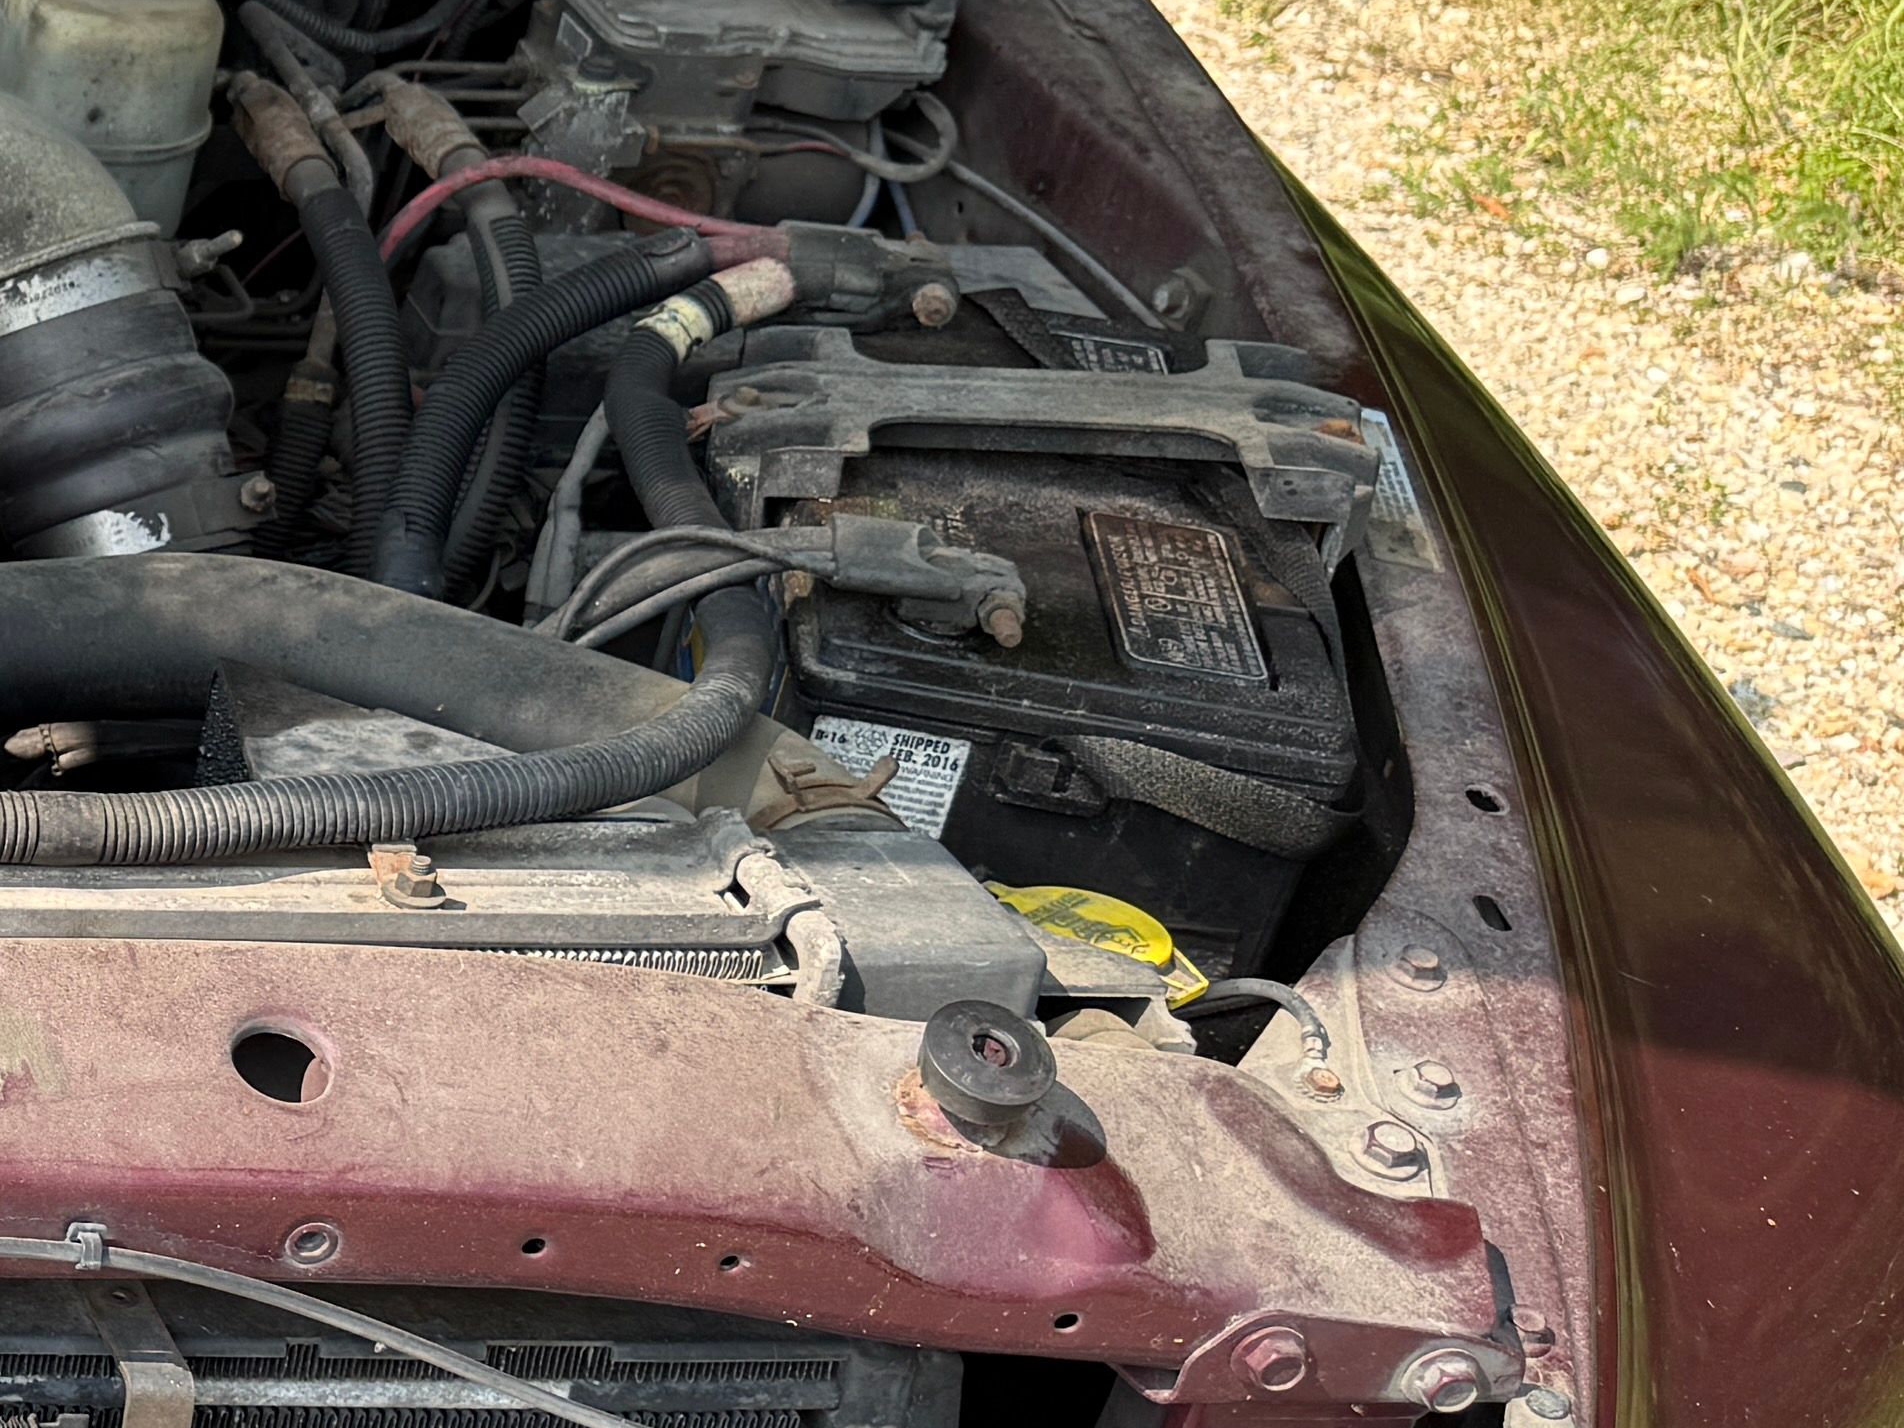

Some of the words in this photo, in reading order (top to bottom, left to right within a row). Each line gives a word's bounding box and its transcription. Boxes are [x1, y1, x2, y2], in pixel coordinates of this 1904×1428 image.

[892, 733, 952, 755] SHIPPED
[890, 746, 918, 765] FEB.
[921, 753, 960, 772] 2016
